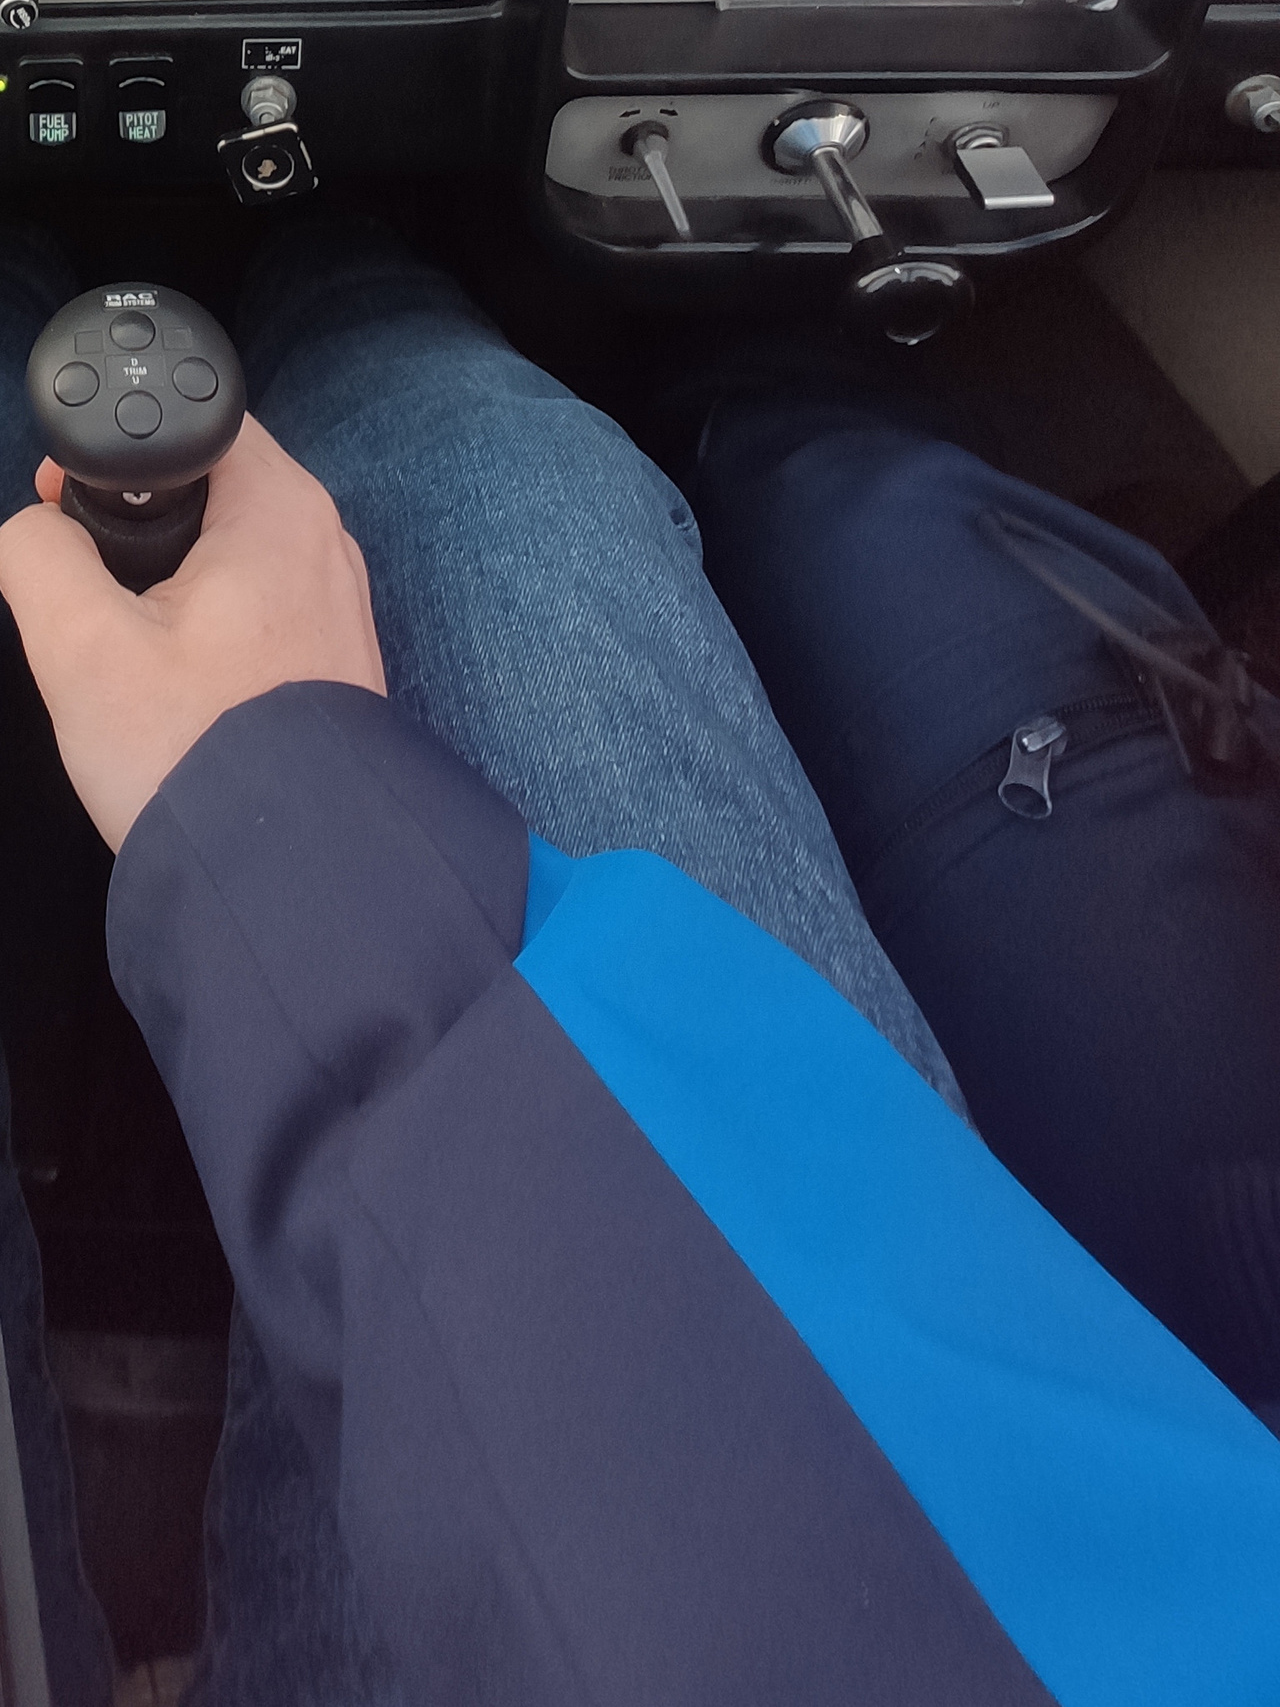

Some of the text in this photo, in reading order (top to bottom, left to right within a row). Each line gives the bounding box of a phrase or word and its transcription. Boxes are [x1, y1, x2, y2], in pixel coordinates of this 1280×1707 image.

[40, 114, 68, 128] FUEL
[126, 112, 158, 127] PITOT
[40, 129, 69, 142] PUMP
[129, 125, 157, 140] HEAT
[123, 366, 147, 376] TRIM
